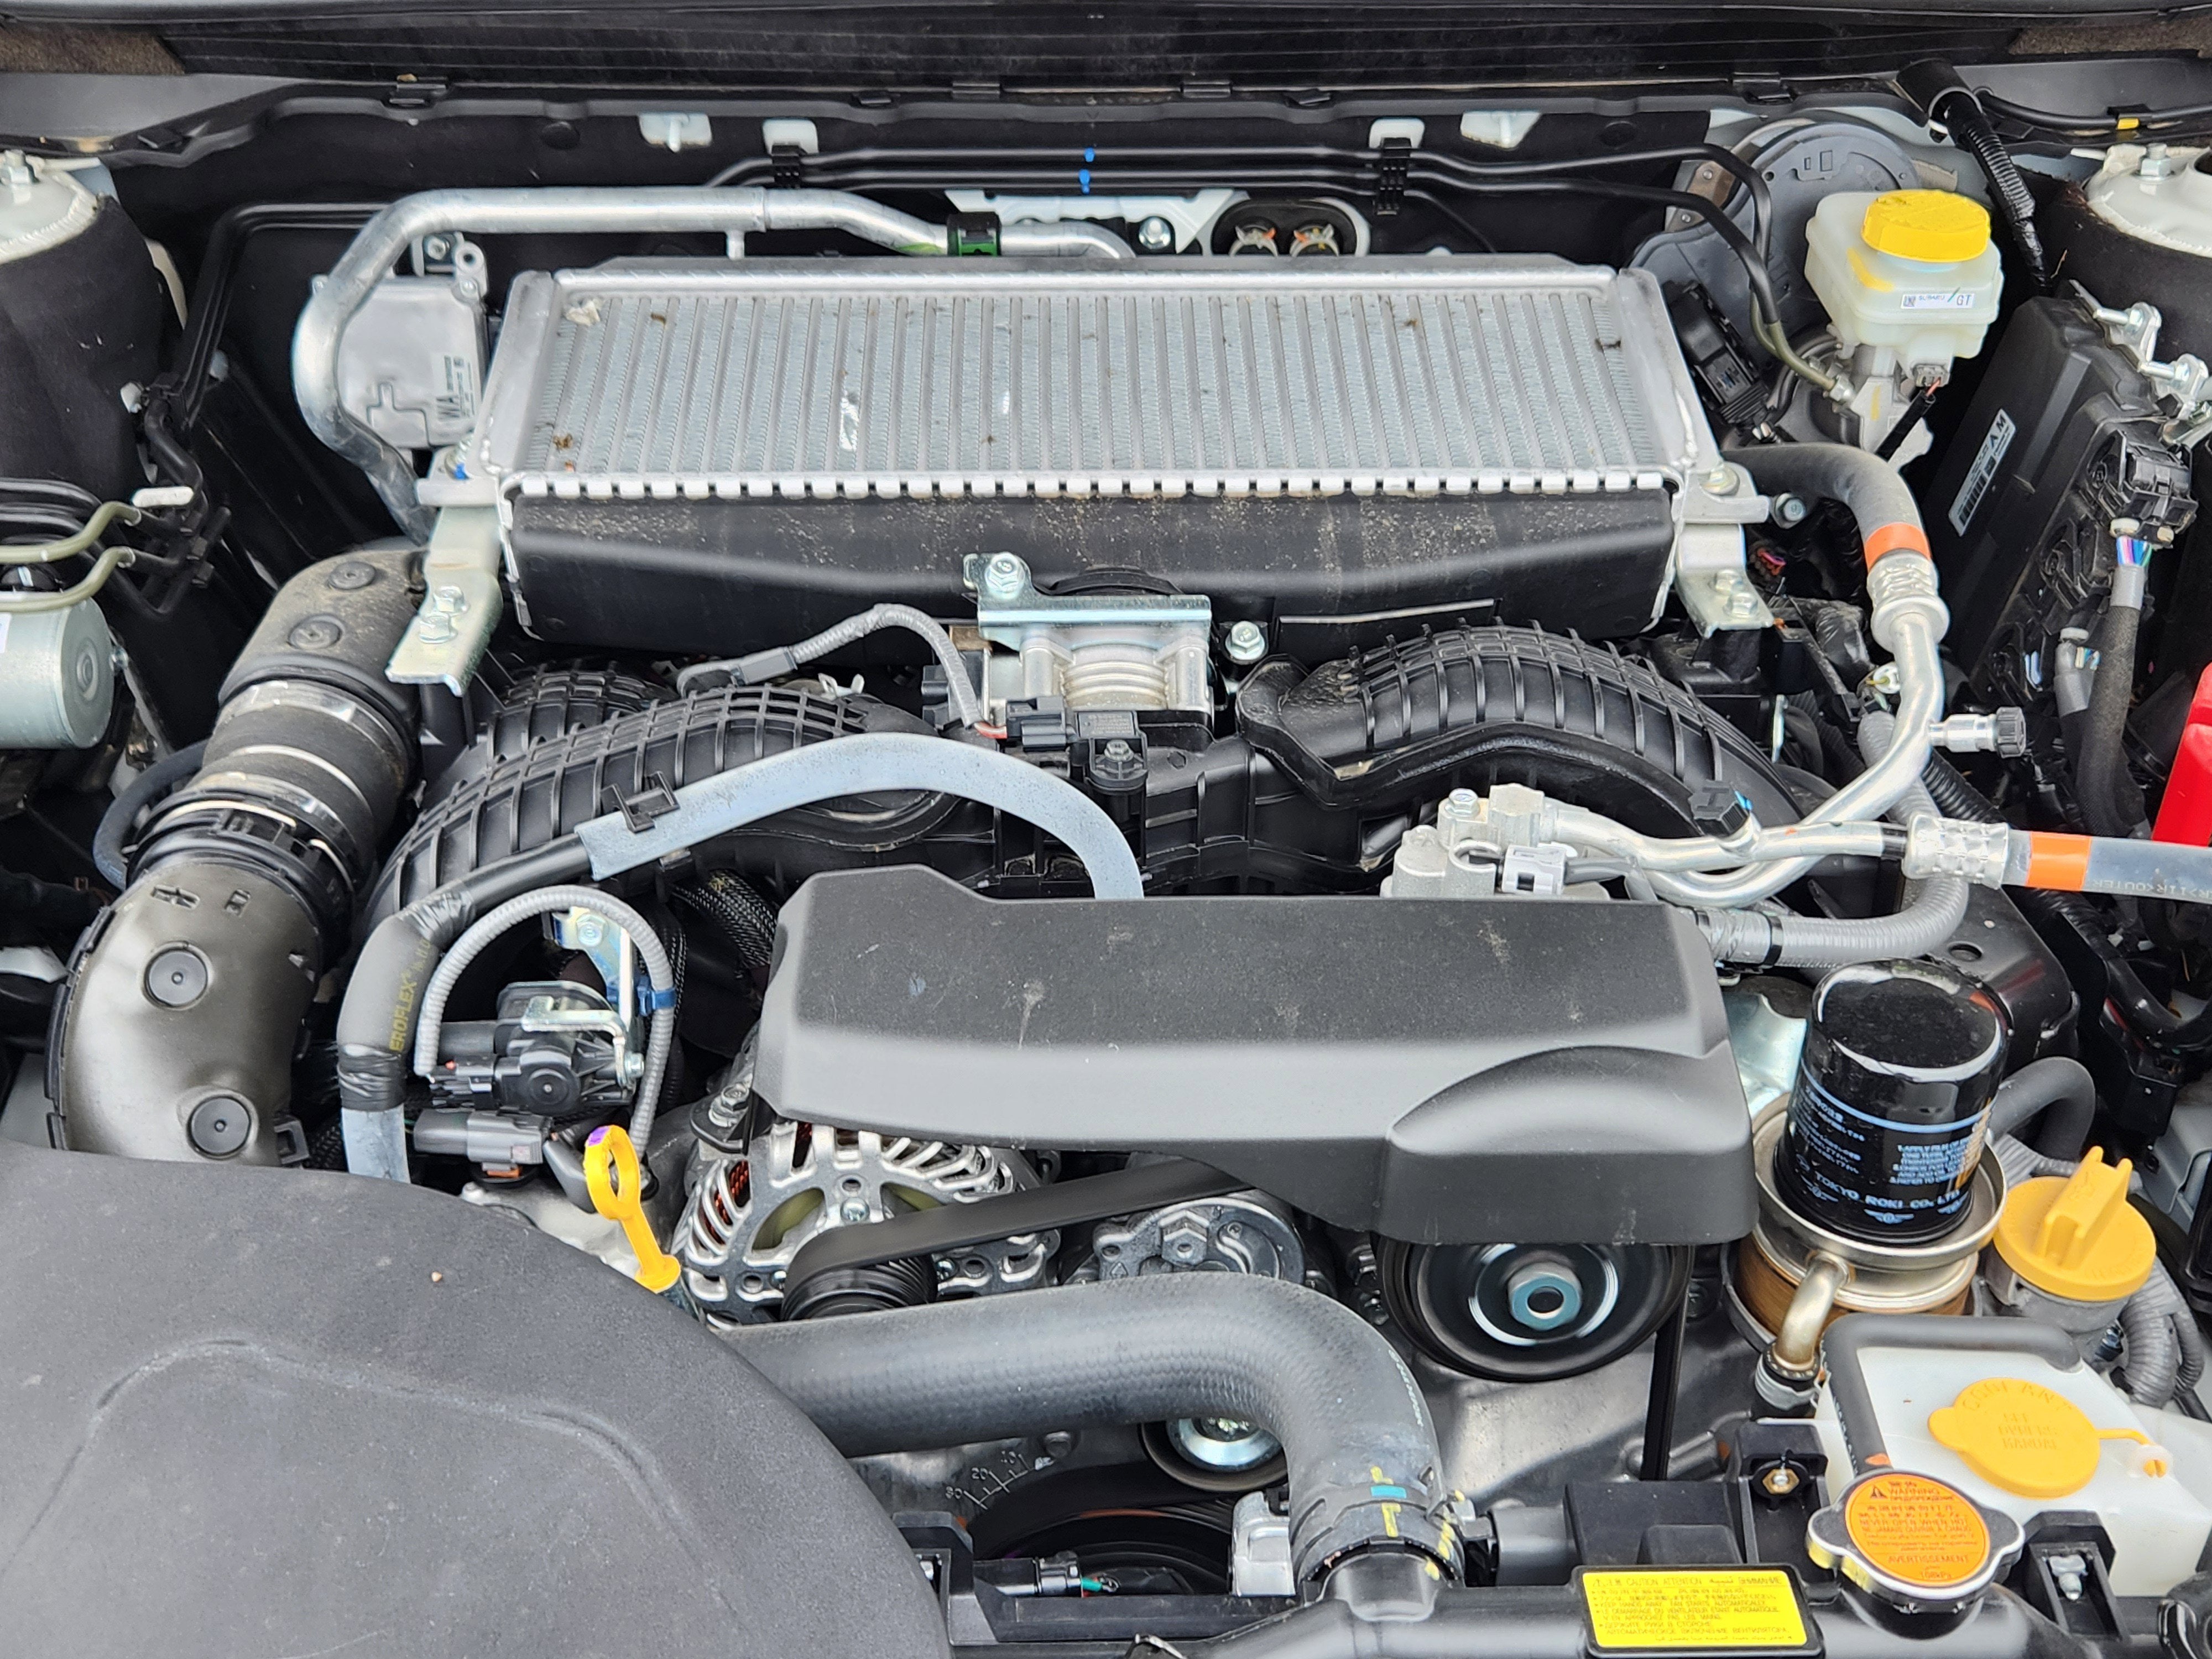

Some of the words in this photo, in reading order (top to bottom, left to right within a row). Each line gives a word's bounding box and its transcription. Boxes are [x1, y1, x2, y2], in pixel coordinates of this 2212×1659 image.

[1957, 294, 1972, 306] GT
[1814, 1170, 1860, 1201] TOKYO
[1865, 1194, 1903, 1209] ROKI
[971, 1467, 989, 1480] 20
[1860, 1519, 1887, 1527] NEVER
[1892, 1519, 1917, 1527] OPEN
[1922, 1519, 1947, 1528] WHEN
[1888, 1555, 1969, 1563] AVERTISSEMENT
[1626, 1578, 1658, 1586] CAUTION
[1663, 1577, 1702, 1585] ATTENTION
